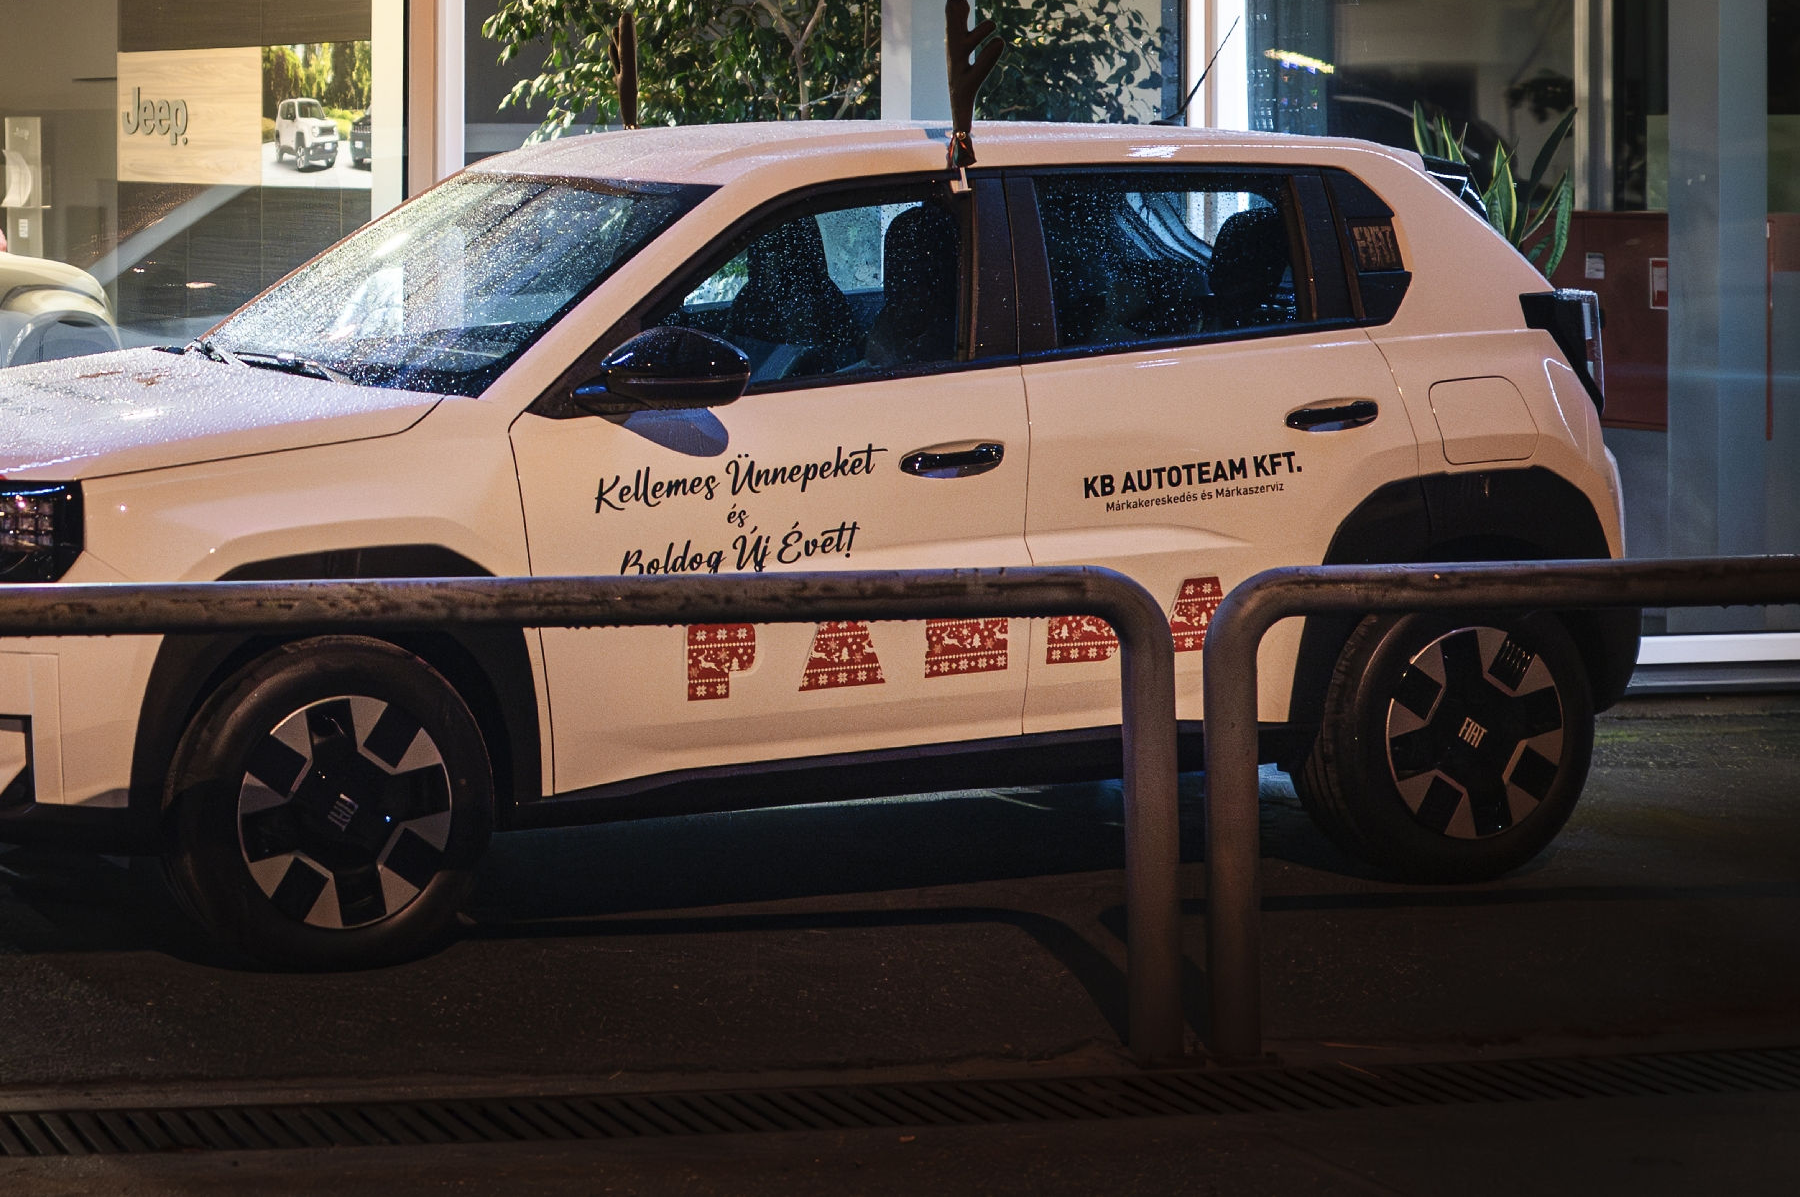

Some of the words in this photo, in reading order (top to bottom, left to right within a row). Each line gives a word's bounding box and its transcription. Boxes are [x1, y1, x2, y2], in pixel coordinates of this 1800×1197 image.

[121, 86, 188, 146] Jeep
[595, 466, 720, 514] Kellemes
[724, 443, 889, 496] Ünnepeket
[1083, 474, 1115, 499] KB
[1120, 457, 1248, 494] AUTOTEAM
[1252, 450, 1303, 478] KFT.
[1105, 490, 1198, 513] Márkakereskedés
[1200, 489, 1213, 501] és
[1215, 480, 1285, 500] Márkaszerviz
[726, 503, 750, 528] és
[732, 526, 771, 573] Új
[776, 521, 861, 564] Évet!
[1458, 716, 1488, 749] FIAT
